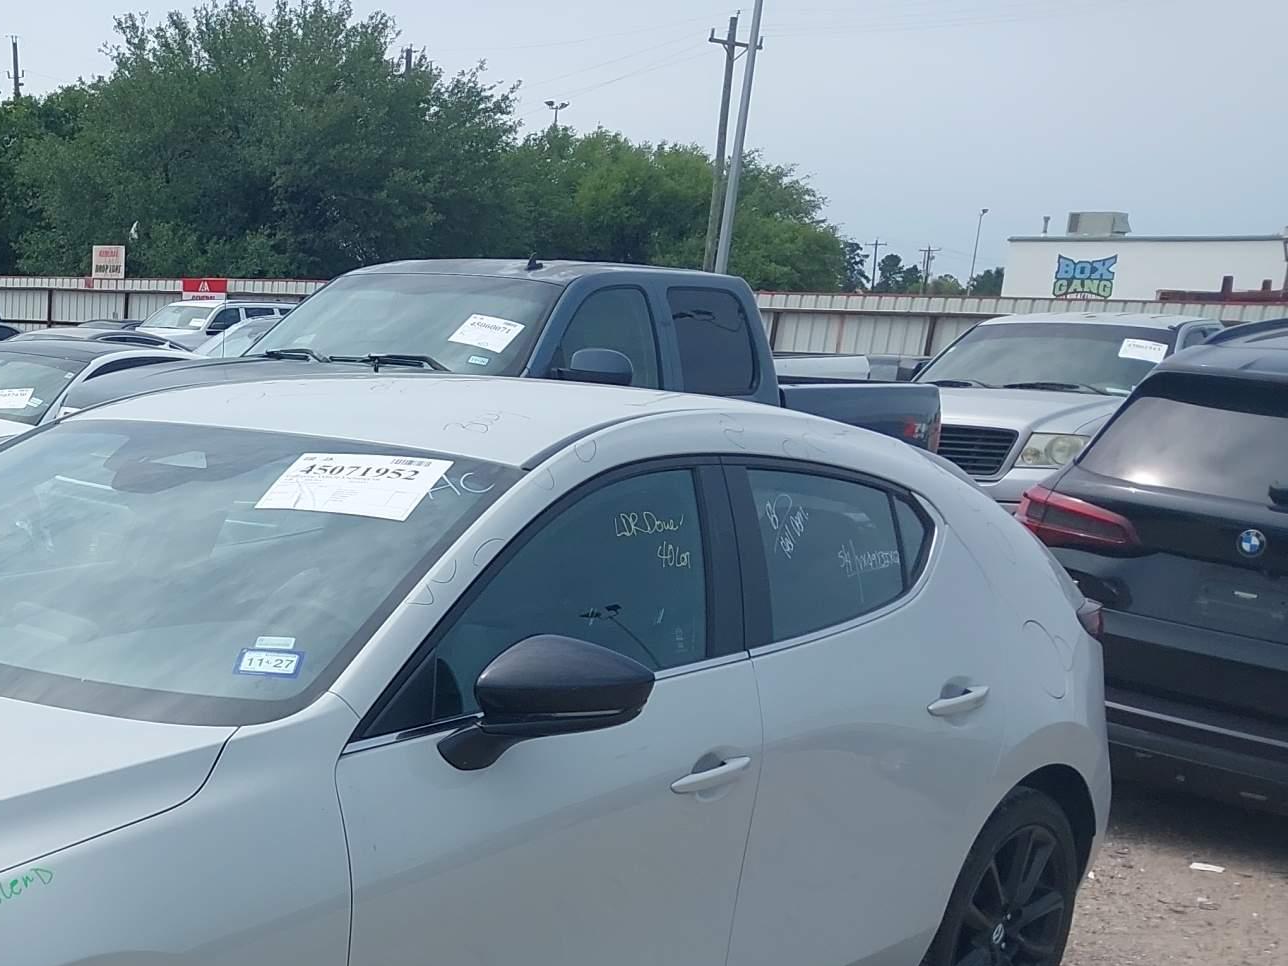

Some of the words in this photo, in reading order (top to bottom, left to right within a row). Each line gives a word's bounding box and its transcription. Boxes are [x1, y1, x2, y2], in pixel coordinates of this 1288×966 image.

[1055, 253, 1118, 280] BOX
[1053, 279, 1113, 299] GANG
[299, 464, 420, 481] 45071952
